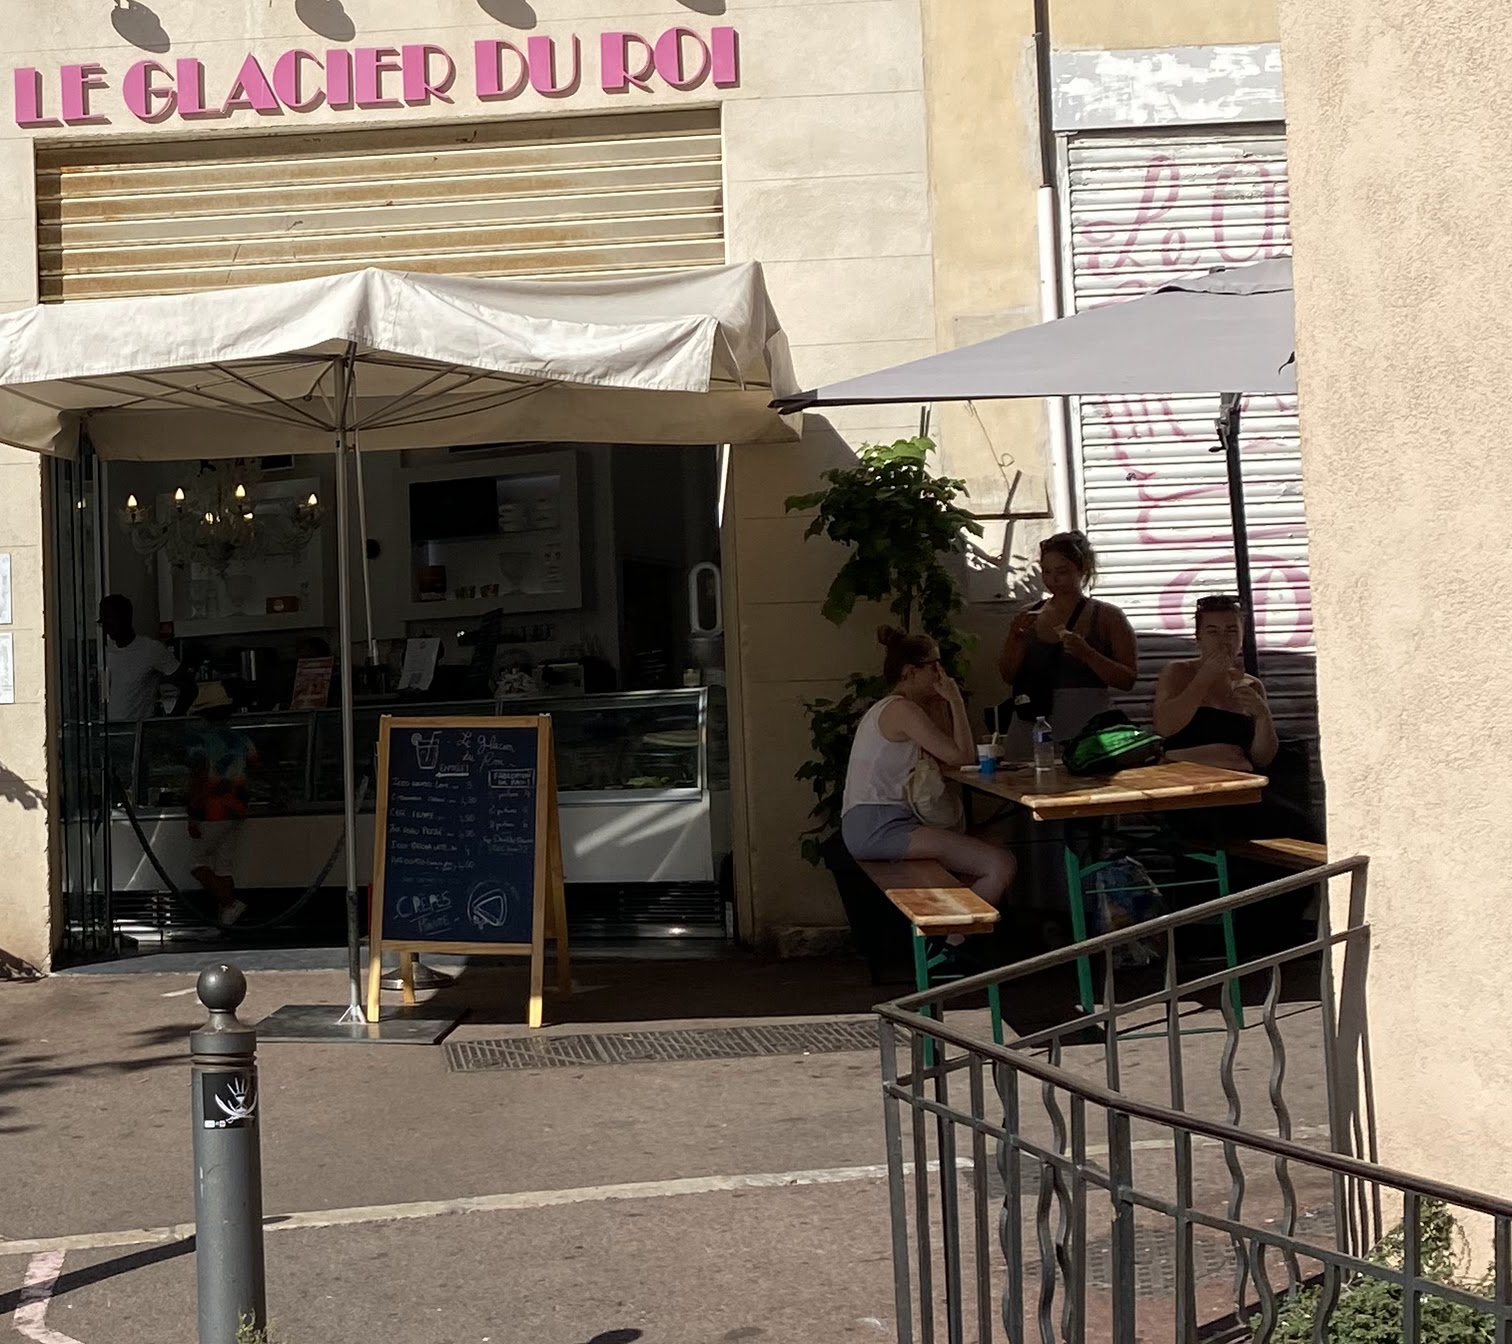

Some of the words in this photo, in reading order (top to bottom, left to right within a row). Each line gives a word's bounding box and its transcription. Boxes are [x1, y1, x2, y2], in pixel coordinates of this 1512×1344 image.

[14, 63, 107, 124] LE
[123, 44, 455, 119] GLACIER
[474, 33, 579, 97] DU
[601, 26, 736, 92] ROI
